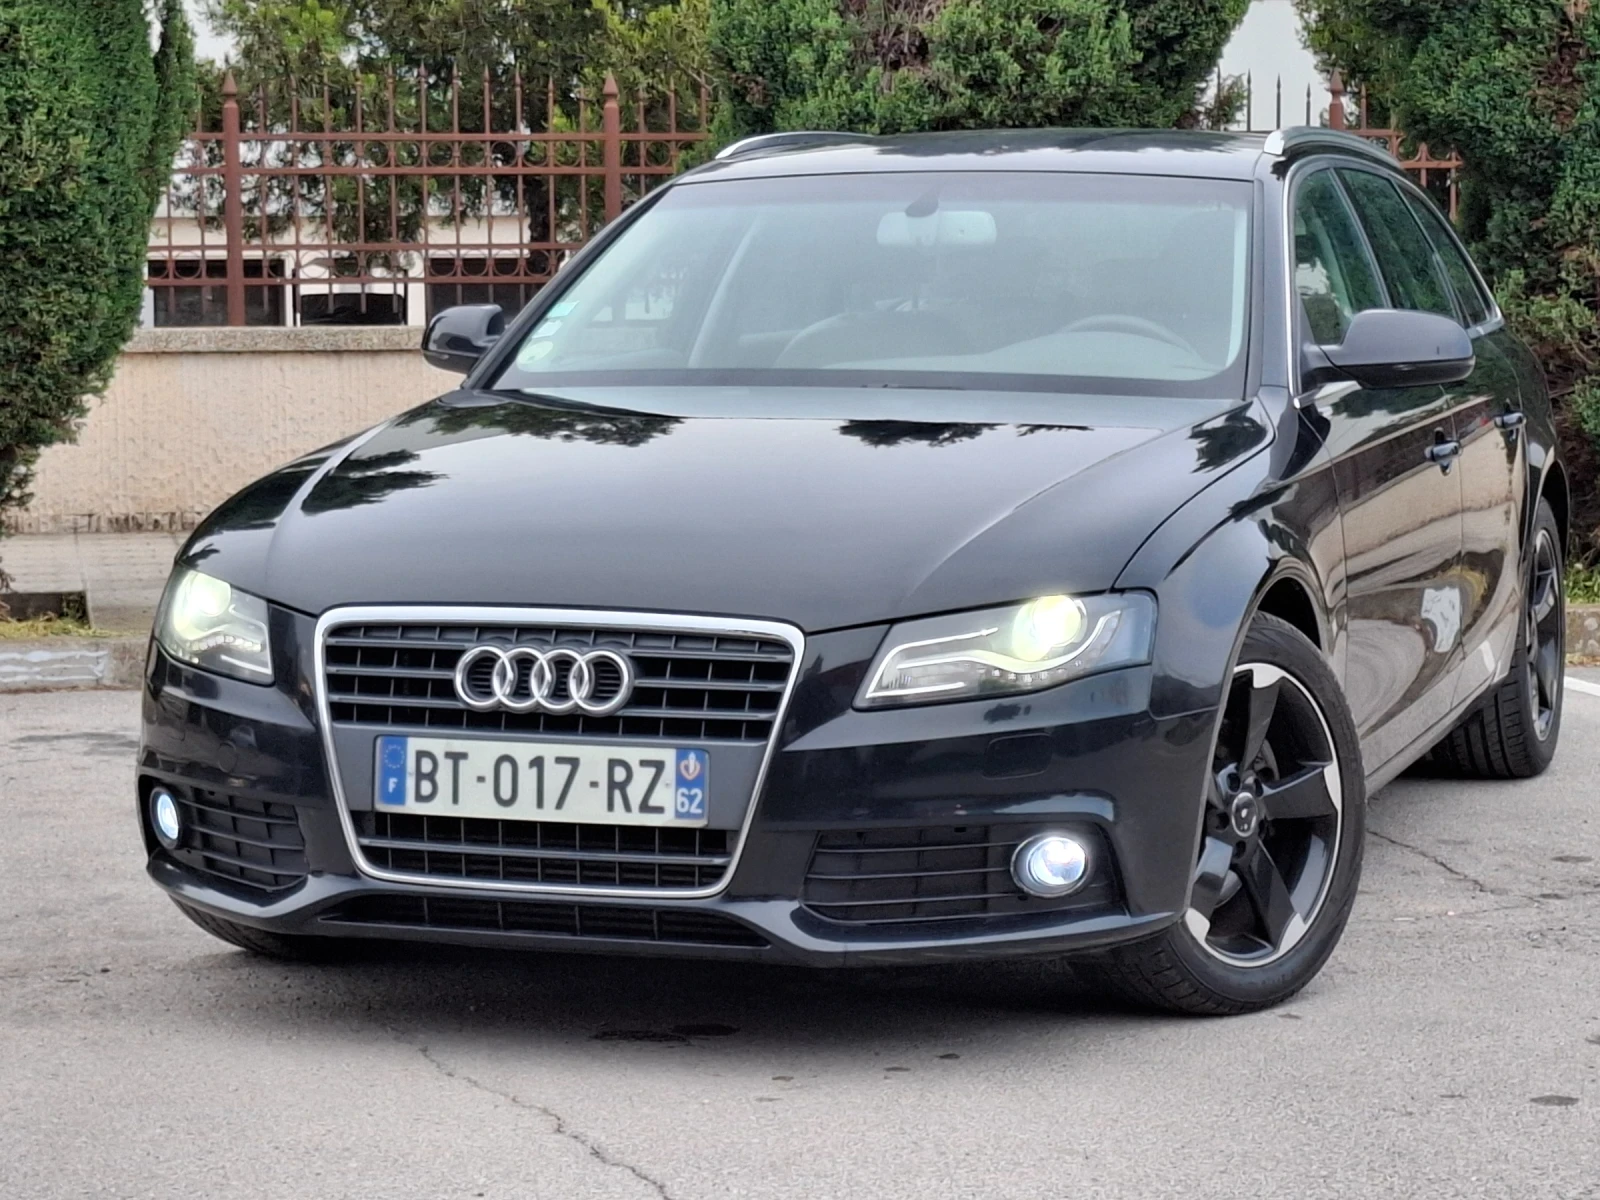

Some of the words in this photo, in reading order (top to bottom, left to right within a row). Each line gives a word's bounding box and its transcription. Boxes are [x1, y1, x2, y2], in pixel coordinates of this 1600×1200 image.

[388, 777, 398, 793] F
[414, 750, 666, 814] BT-017-RZ
[676, 787, 703, 814] 62
